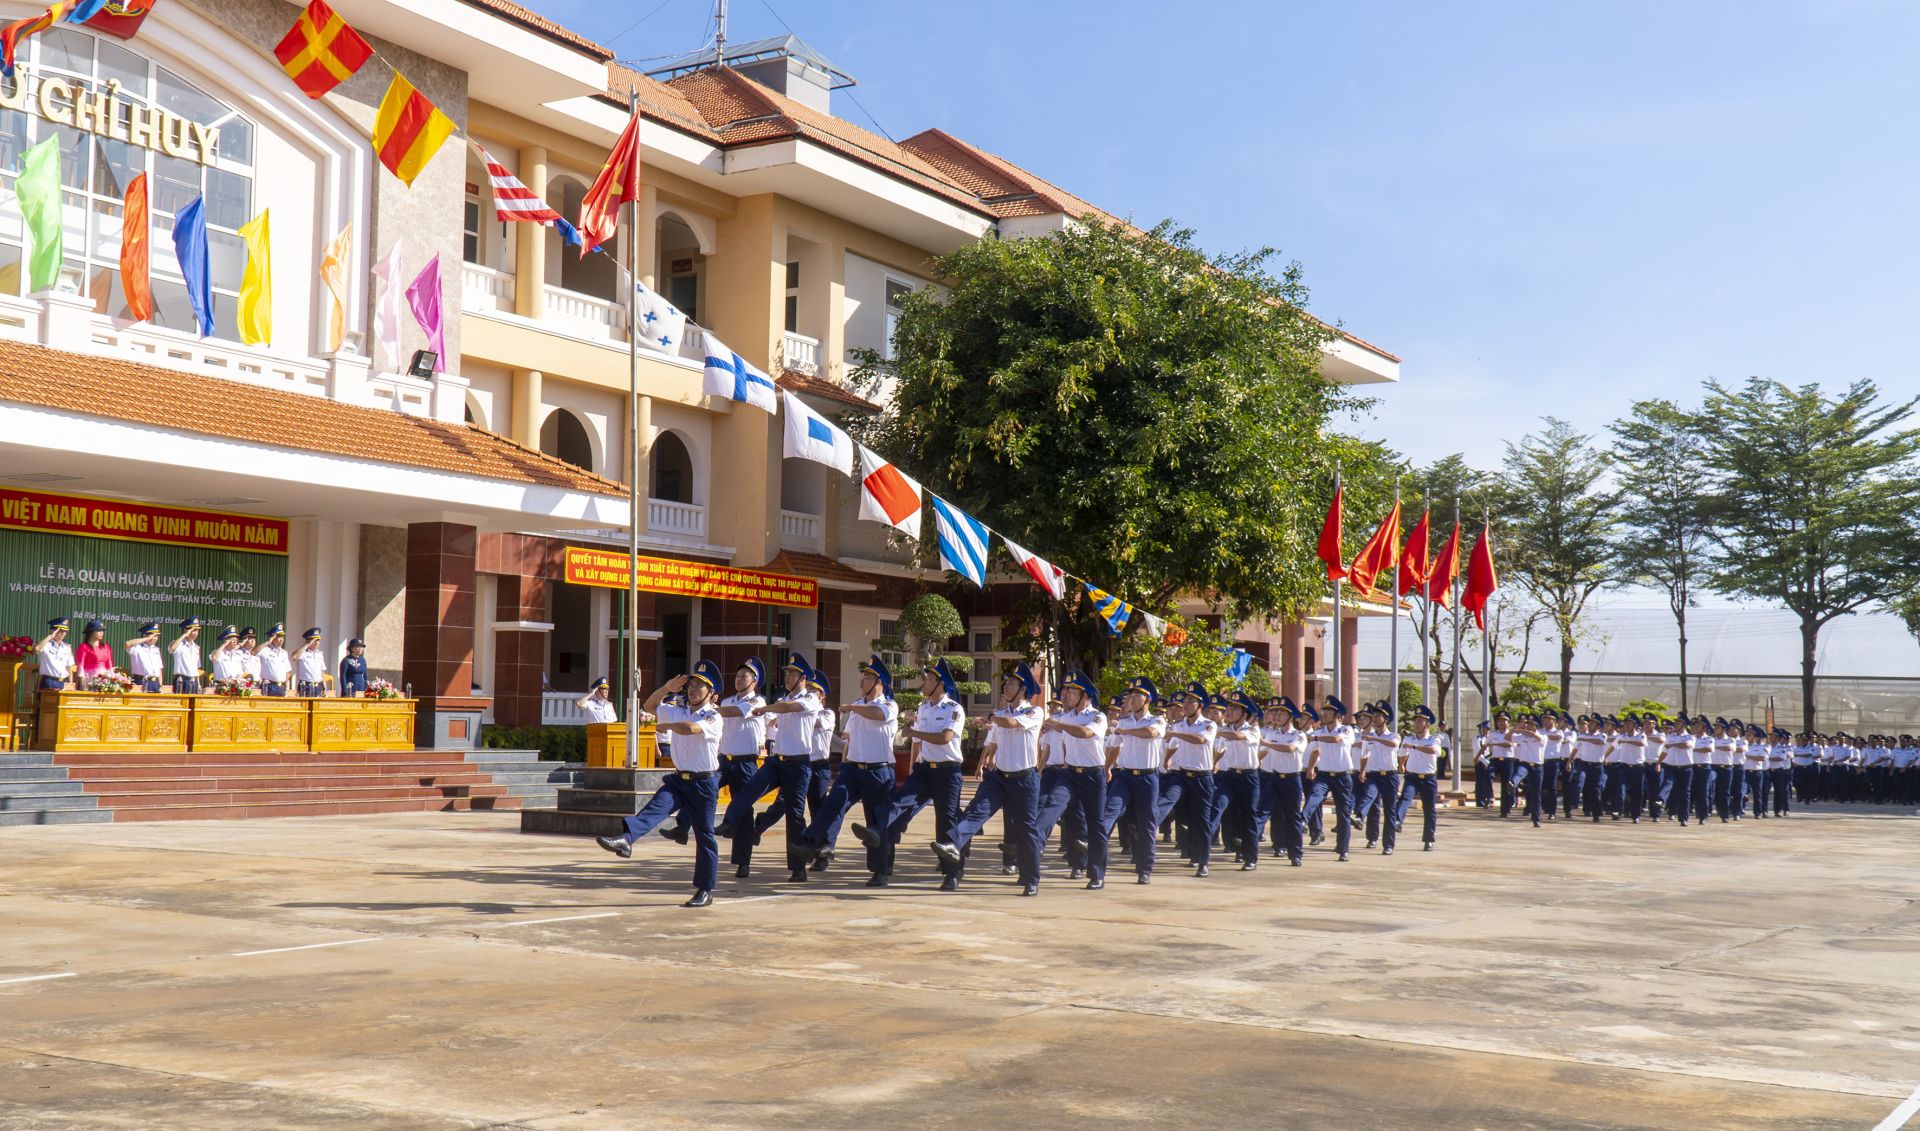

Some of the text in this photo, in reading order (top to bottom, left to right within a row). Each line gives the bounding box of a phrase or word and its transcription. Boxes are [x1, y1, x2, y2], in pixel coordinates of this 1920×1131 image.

[38, 78, 121, 138] CHỈ
[130, 102, 220, 167] HUY
[2, 497, 278, 545] VIỆT NAM QUANG VINH MUÔN NĂM
[571, 553, 592, 565] QUYẾT
[593, 555, 607, 567] TÂM
[609, 557, 626, 569] HOÀN
[40, 562, 253, 594] LỄ RA QUÂN HUẤN LUYỆN NĂM 2025
[575, 568, 584, 579] VÀ
[585, 570, 599, 580] XÂY
[672, 578, 684, 588] SÁT
[10, 582, 22, 592] VÀ
[24, 583, 47, 594] PHÁT
[49, 584, 76, 597] ĐỘNG
[97, 589, 111, 598] THI
[113, 589, 131, 600] ĐUA
[133, 592, 150, 601] CAO
